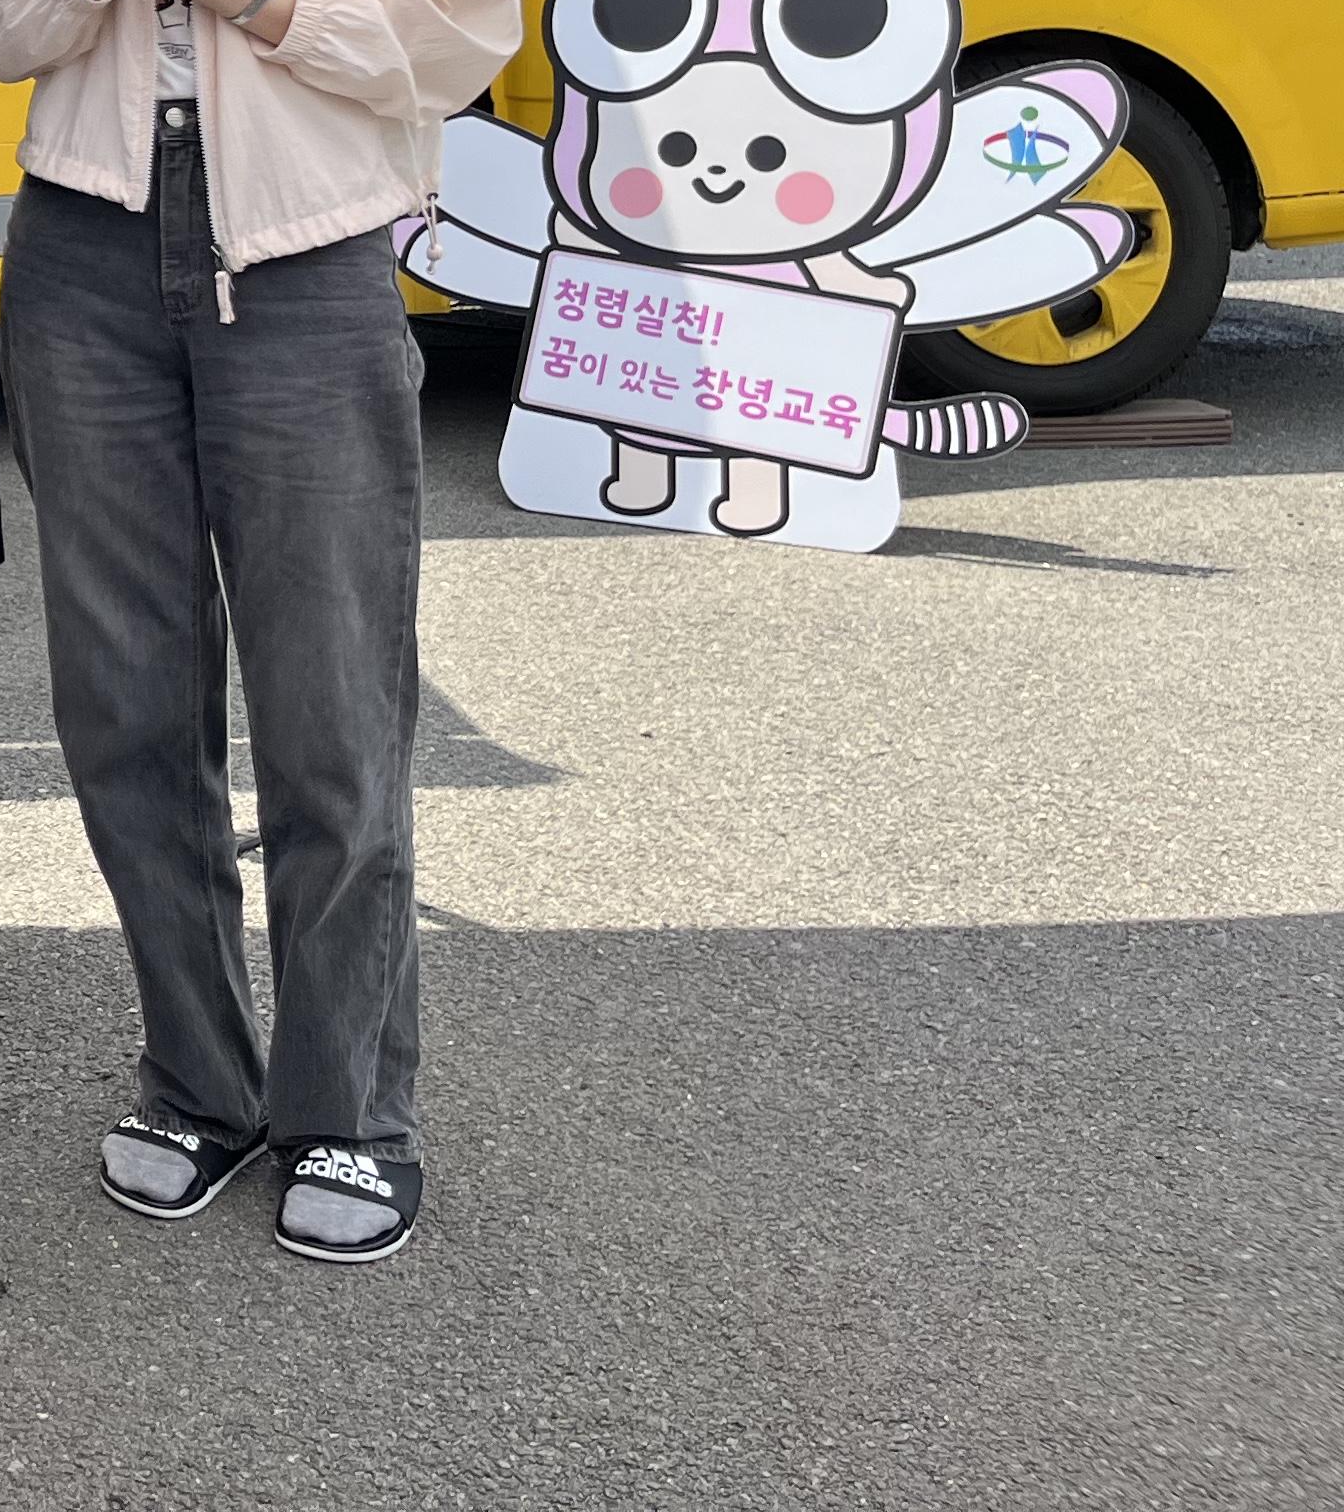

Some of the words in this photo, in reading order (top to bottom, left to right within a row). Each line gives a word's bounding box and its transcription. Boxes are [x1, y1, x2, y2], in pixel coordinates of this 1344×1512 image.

[553, 278, 725, 346] 청렴실천!
[541, 335, 609, 387] 꿈이
[618, 358, 680, 401] 있는
[691, 365, 862, 440] 창녕교육
[294, 1155, 394, 1199] adidas
